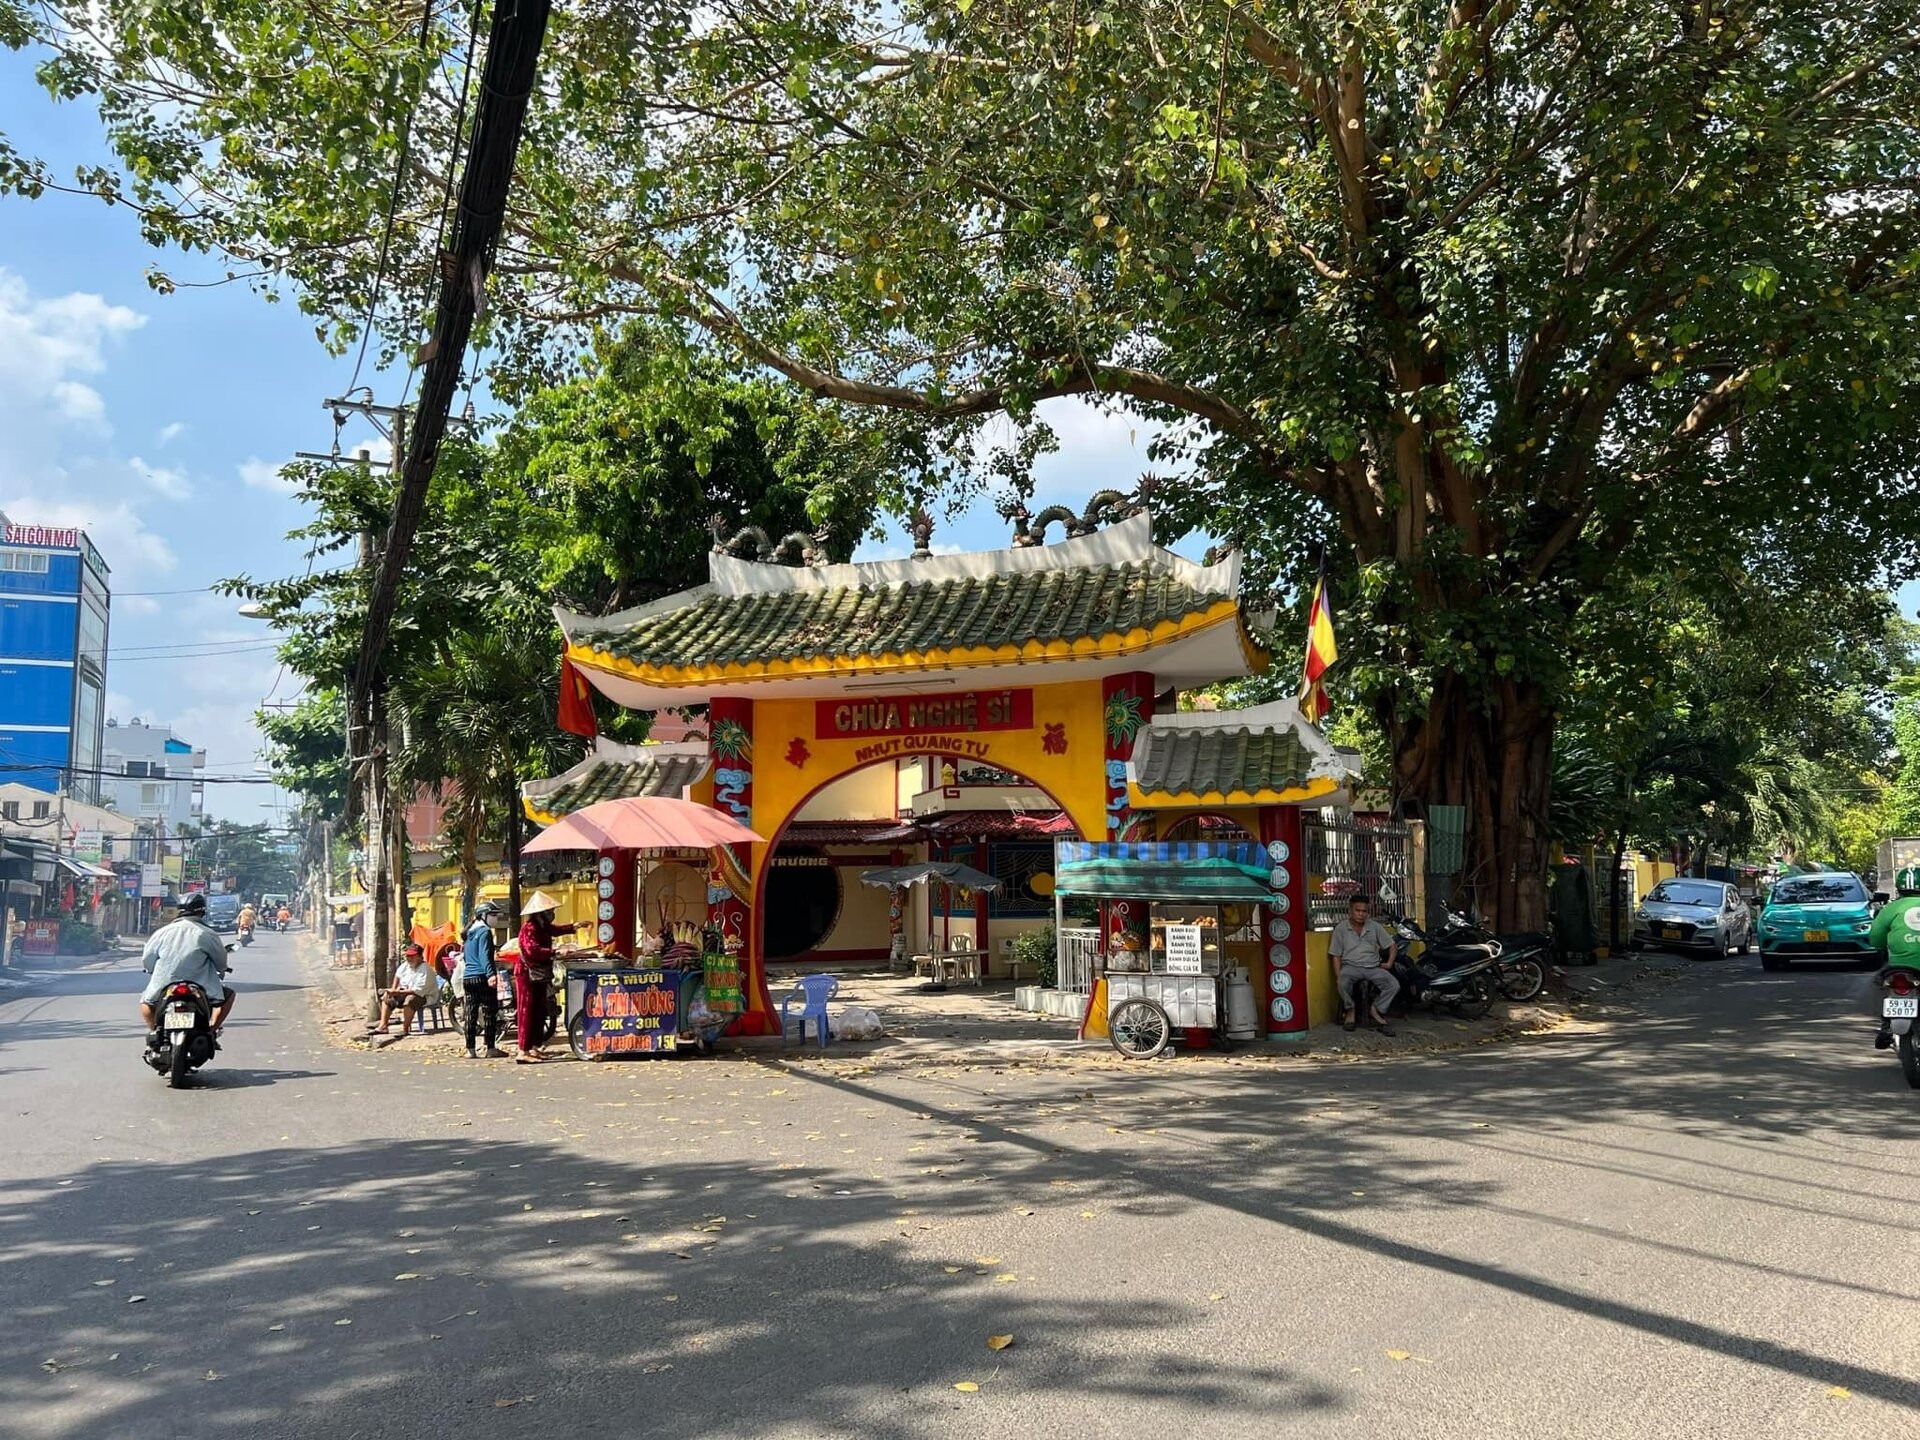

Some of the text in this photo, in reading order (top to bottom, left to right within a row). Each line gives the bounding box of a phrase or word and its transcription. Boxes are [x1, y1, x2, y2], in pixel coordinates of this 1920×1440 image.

[834, 690, 1012, 732] CHÙA NGHỆ SĨ
[903, 735, 962, 752] QUANG
[1889, 999, 1914, 1007] 59-V3
[601, 1018, 624, 1031] 20K
[636, 1017, 660, 1029] 30K
[657, 1035, 676, 1049] 15K
